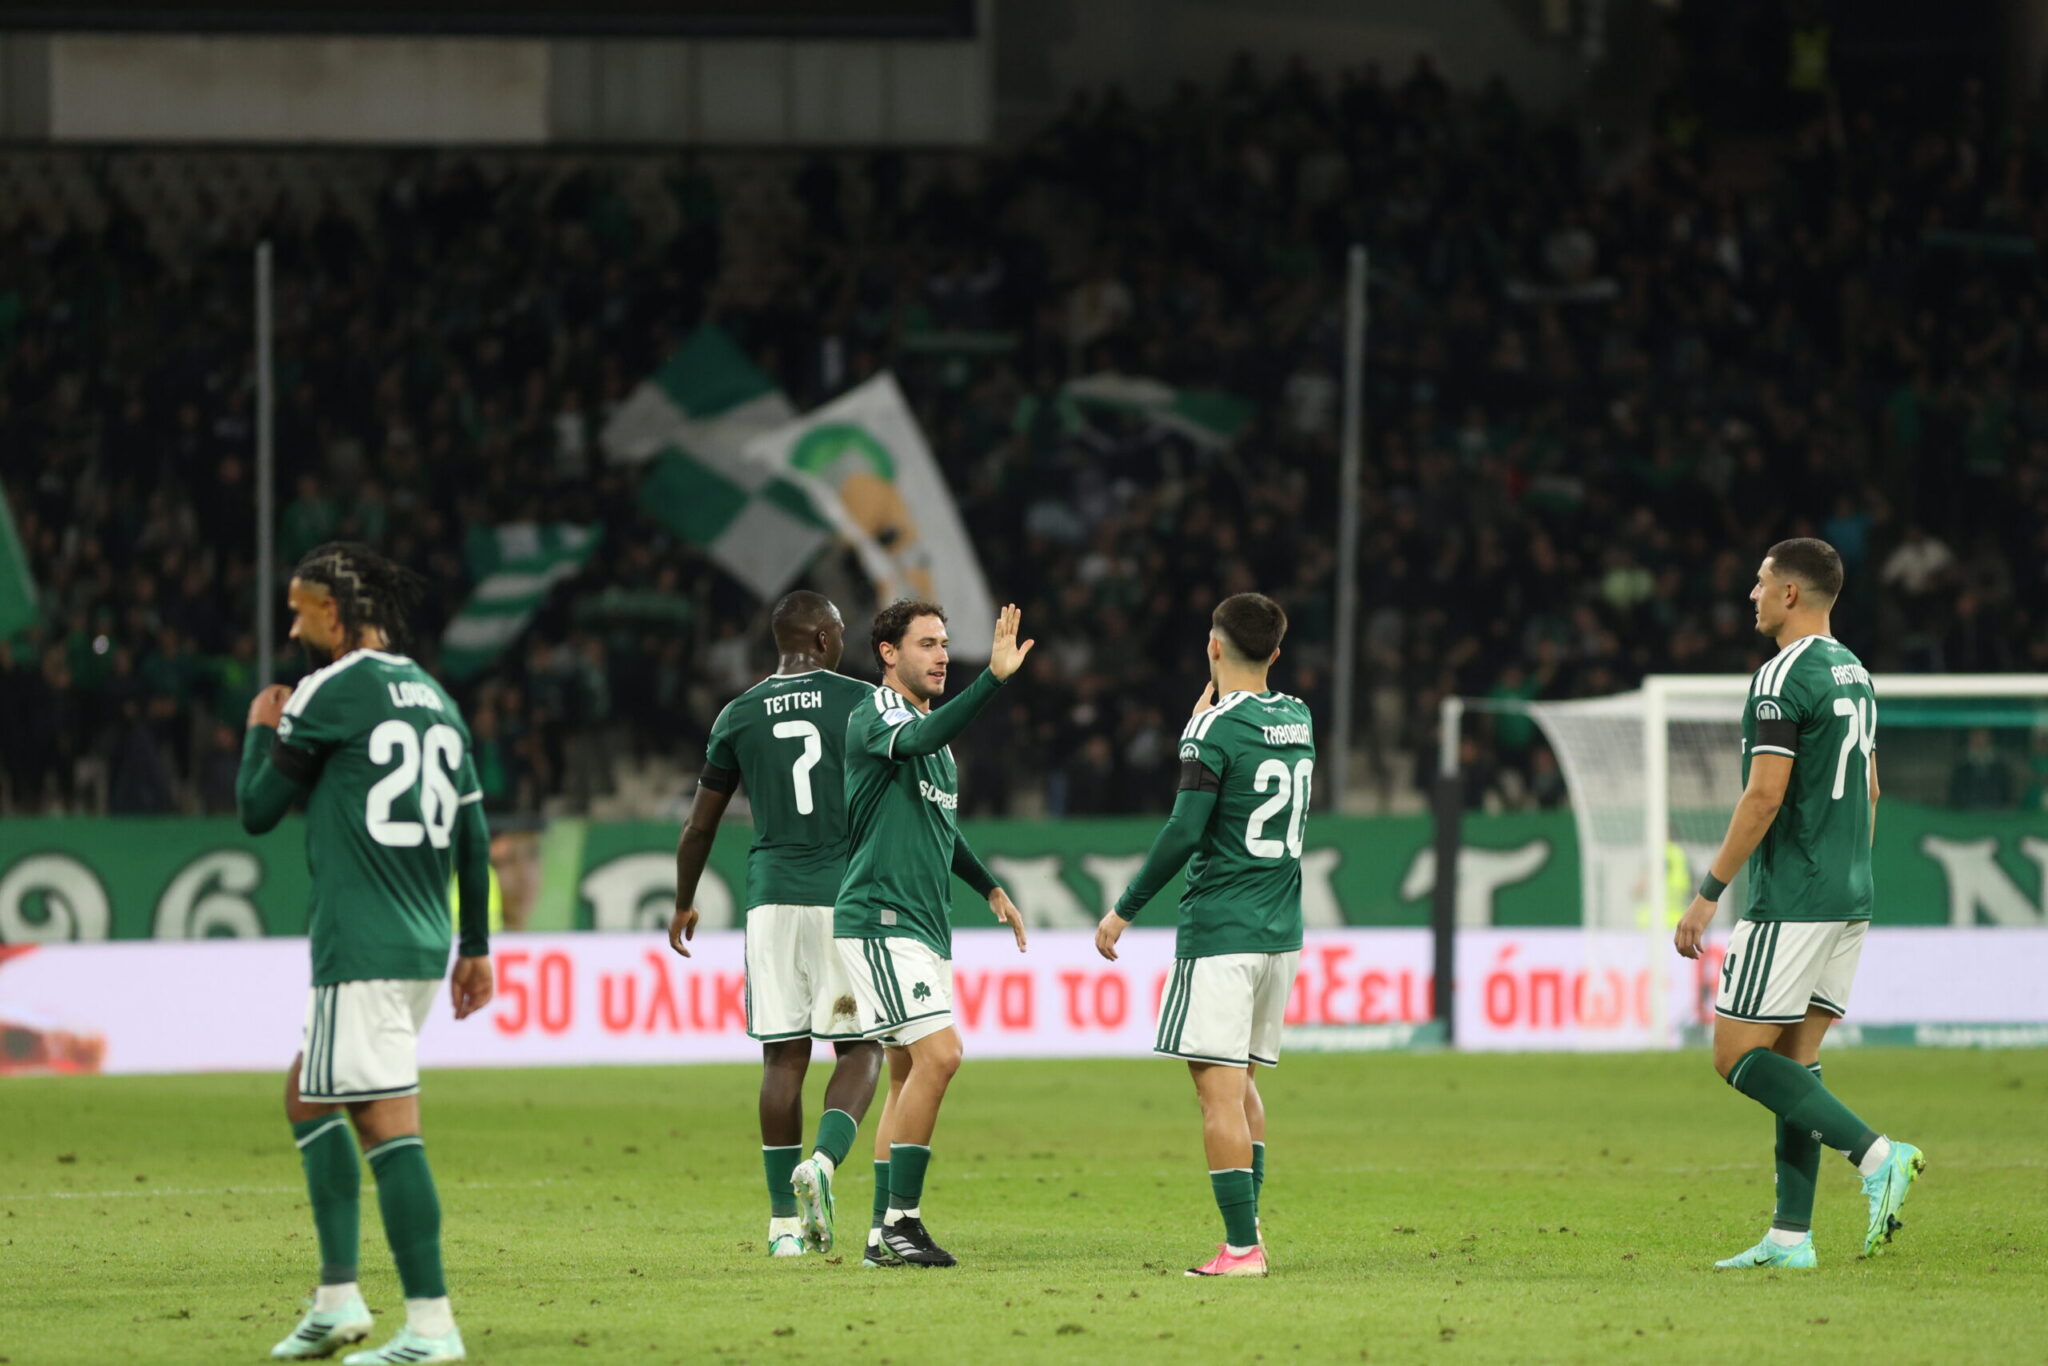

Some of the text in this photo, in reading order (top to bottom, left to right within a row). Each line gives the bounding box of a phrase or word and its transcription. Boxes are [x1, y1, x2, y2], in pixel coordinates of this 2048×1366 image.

[763, 690, 823, 716] TETTEH
[1261, 723, 1311, 745] TABORDA
[1832, 697, 1877, 800] 74
[366, 719, 464, 849] 26
[772, 720, 823, 815] 7
[1245, 758, 1314, 859] 20
[597, 950, 747, 1033] υλικ
